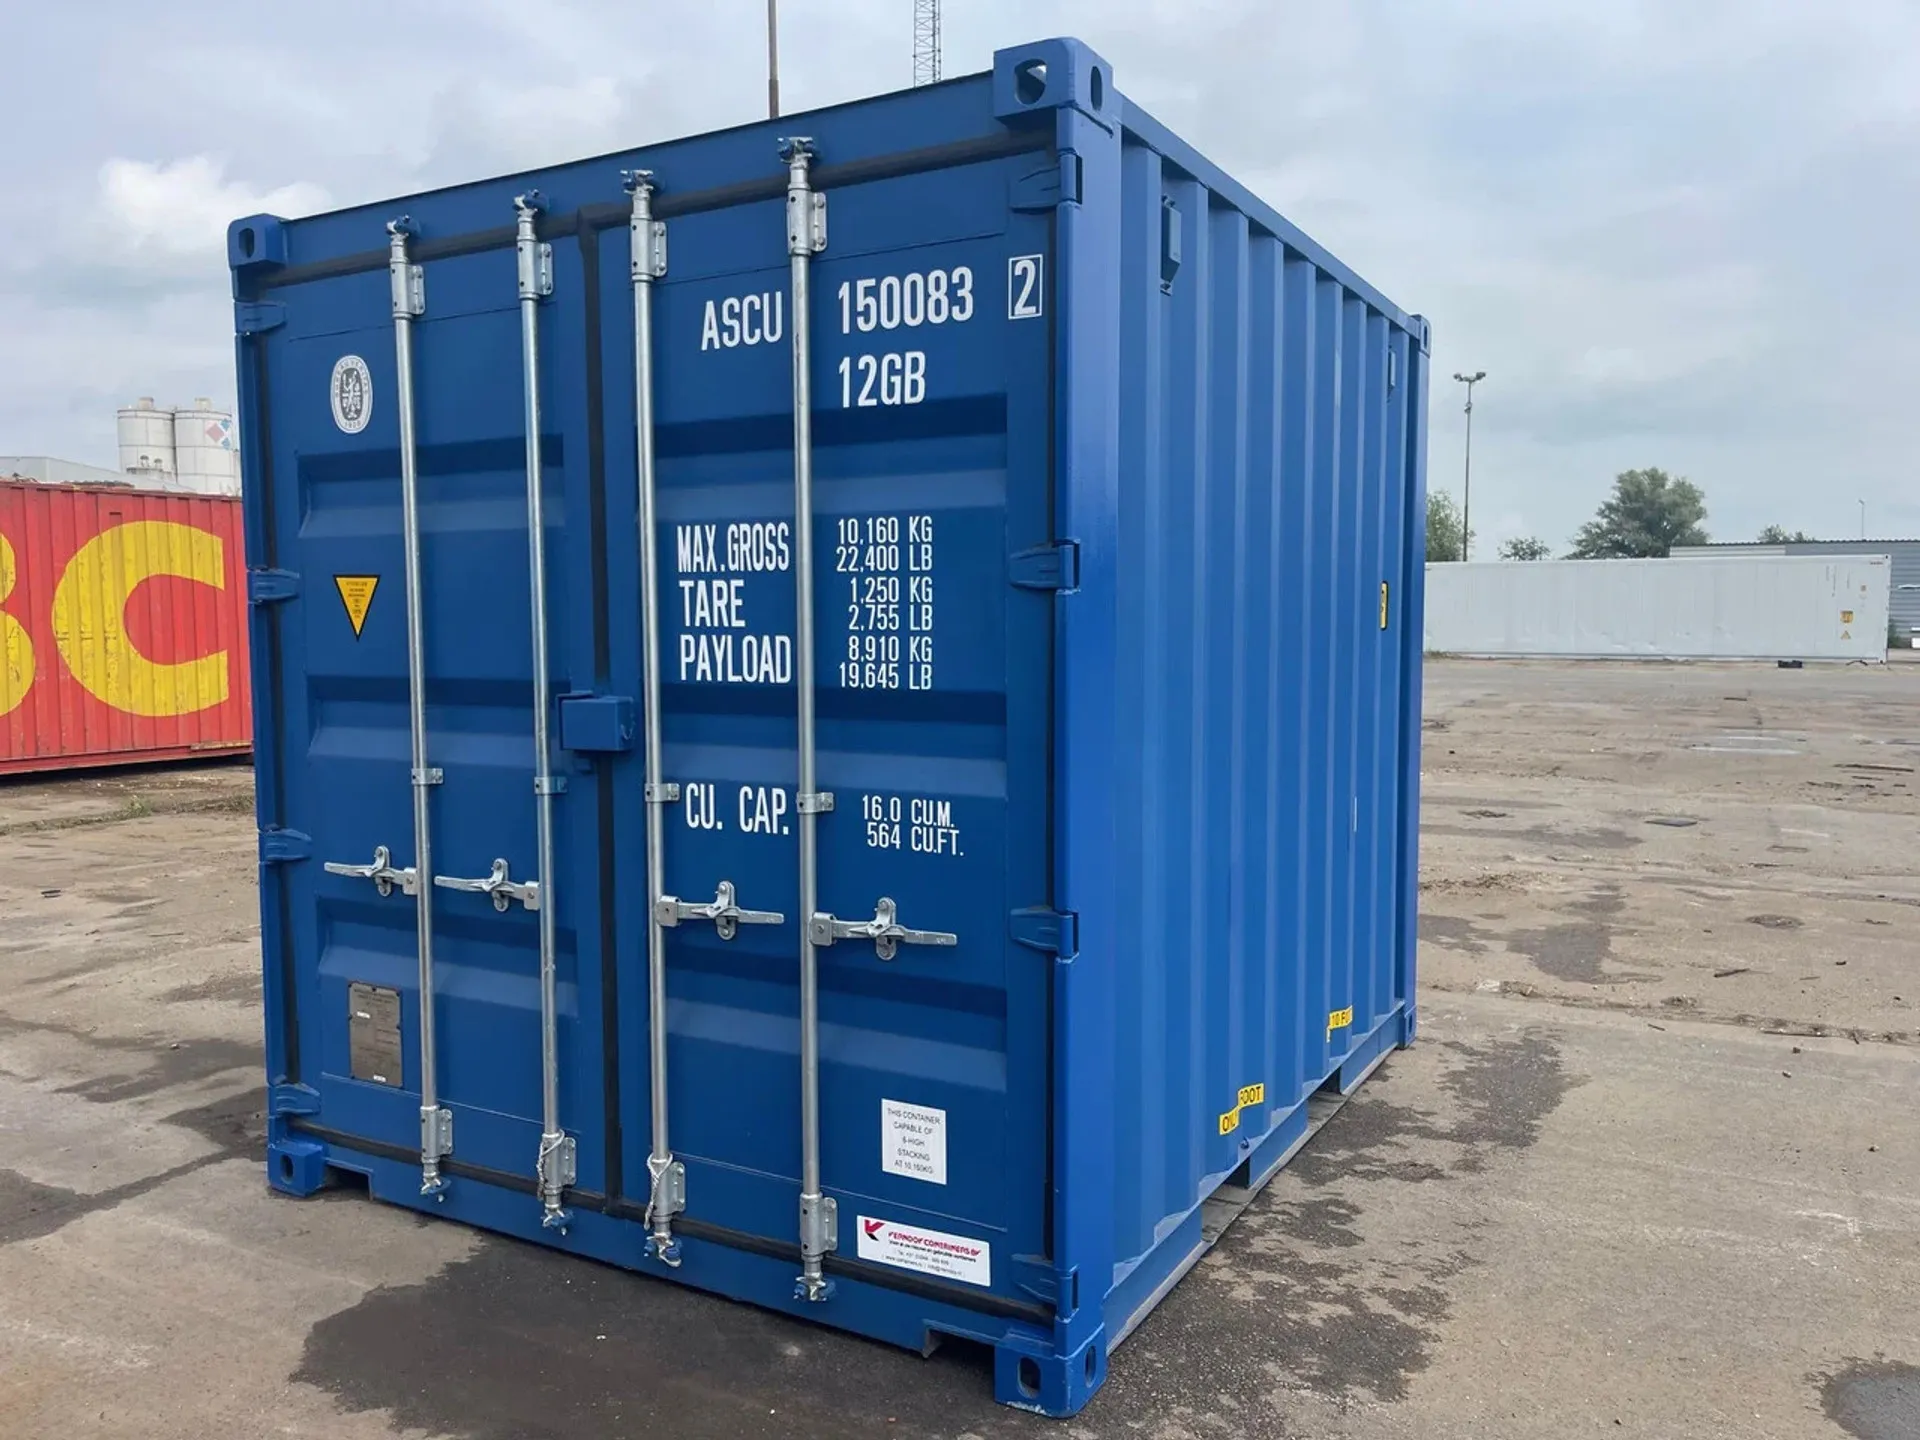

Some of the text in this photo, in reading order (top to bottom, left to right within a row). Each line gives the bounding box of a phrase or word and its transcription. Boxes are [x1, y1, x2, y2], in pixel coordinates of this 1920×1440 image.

[702, 259, 1037, 350] ASCU 150083 2
[840, 352, 925, 407] 12GB
[839, 516, 932, 544] 10,160 KG
[678, 522, 788, 572] MAX.GROSS
[837, 545, 932, 572] 22,400 LB
[679, 580, 745, 626] TARE
[851, 577, 932, 603] 1,250 KG
[0, 520, 229, 717] C
[849, 605, 932, 630] 2,755 LB
[681, 635, 790, 683] PAYLOAD
[849, 636, 932, 662] 8,910 KG
[840, 663, 931, 689] 19,645 LB
[686, 783, 788, 834] CU. CAP.
[863, 795, 900, 823] 16.0
[868, 821, 900, 848] 564
[887, 1107, 941, 1124] THIS CONTAINER
[893, 1121, 933, 1135] CAPABLE OF
[897, 1148, 930, 1161] STACKING
